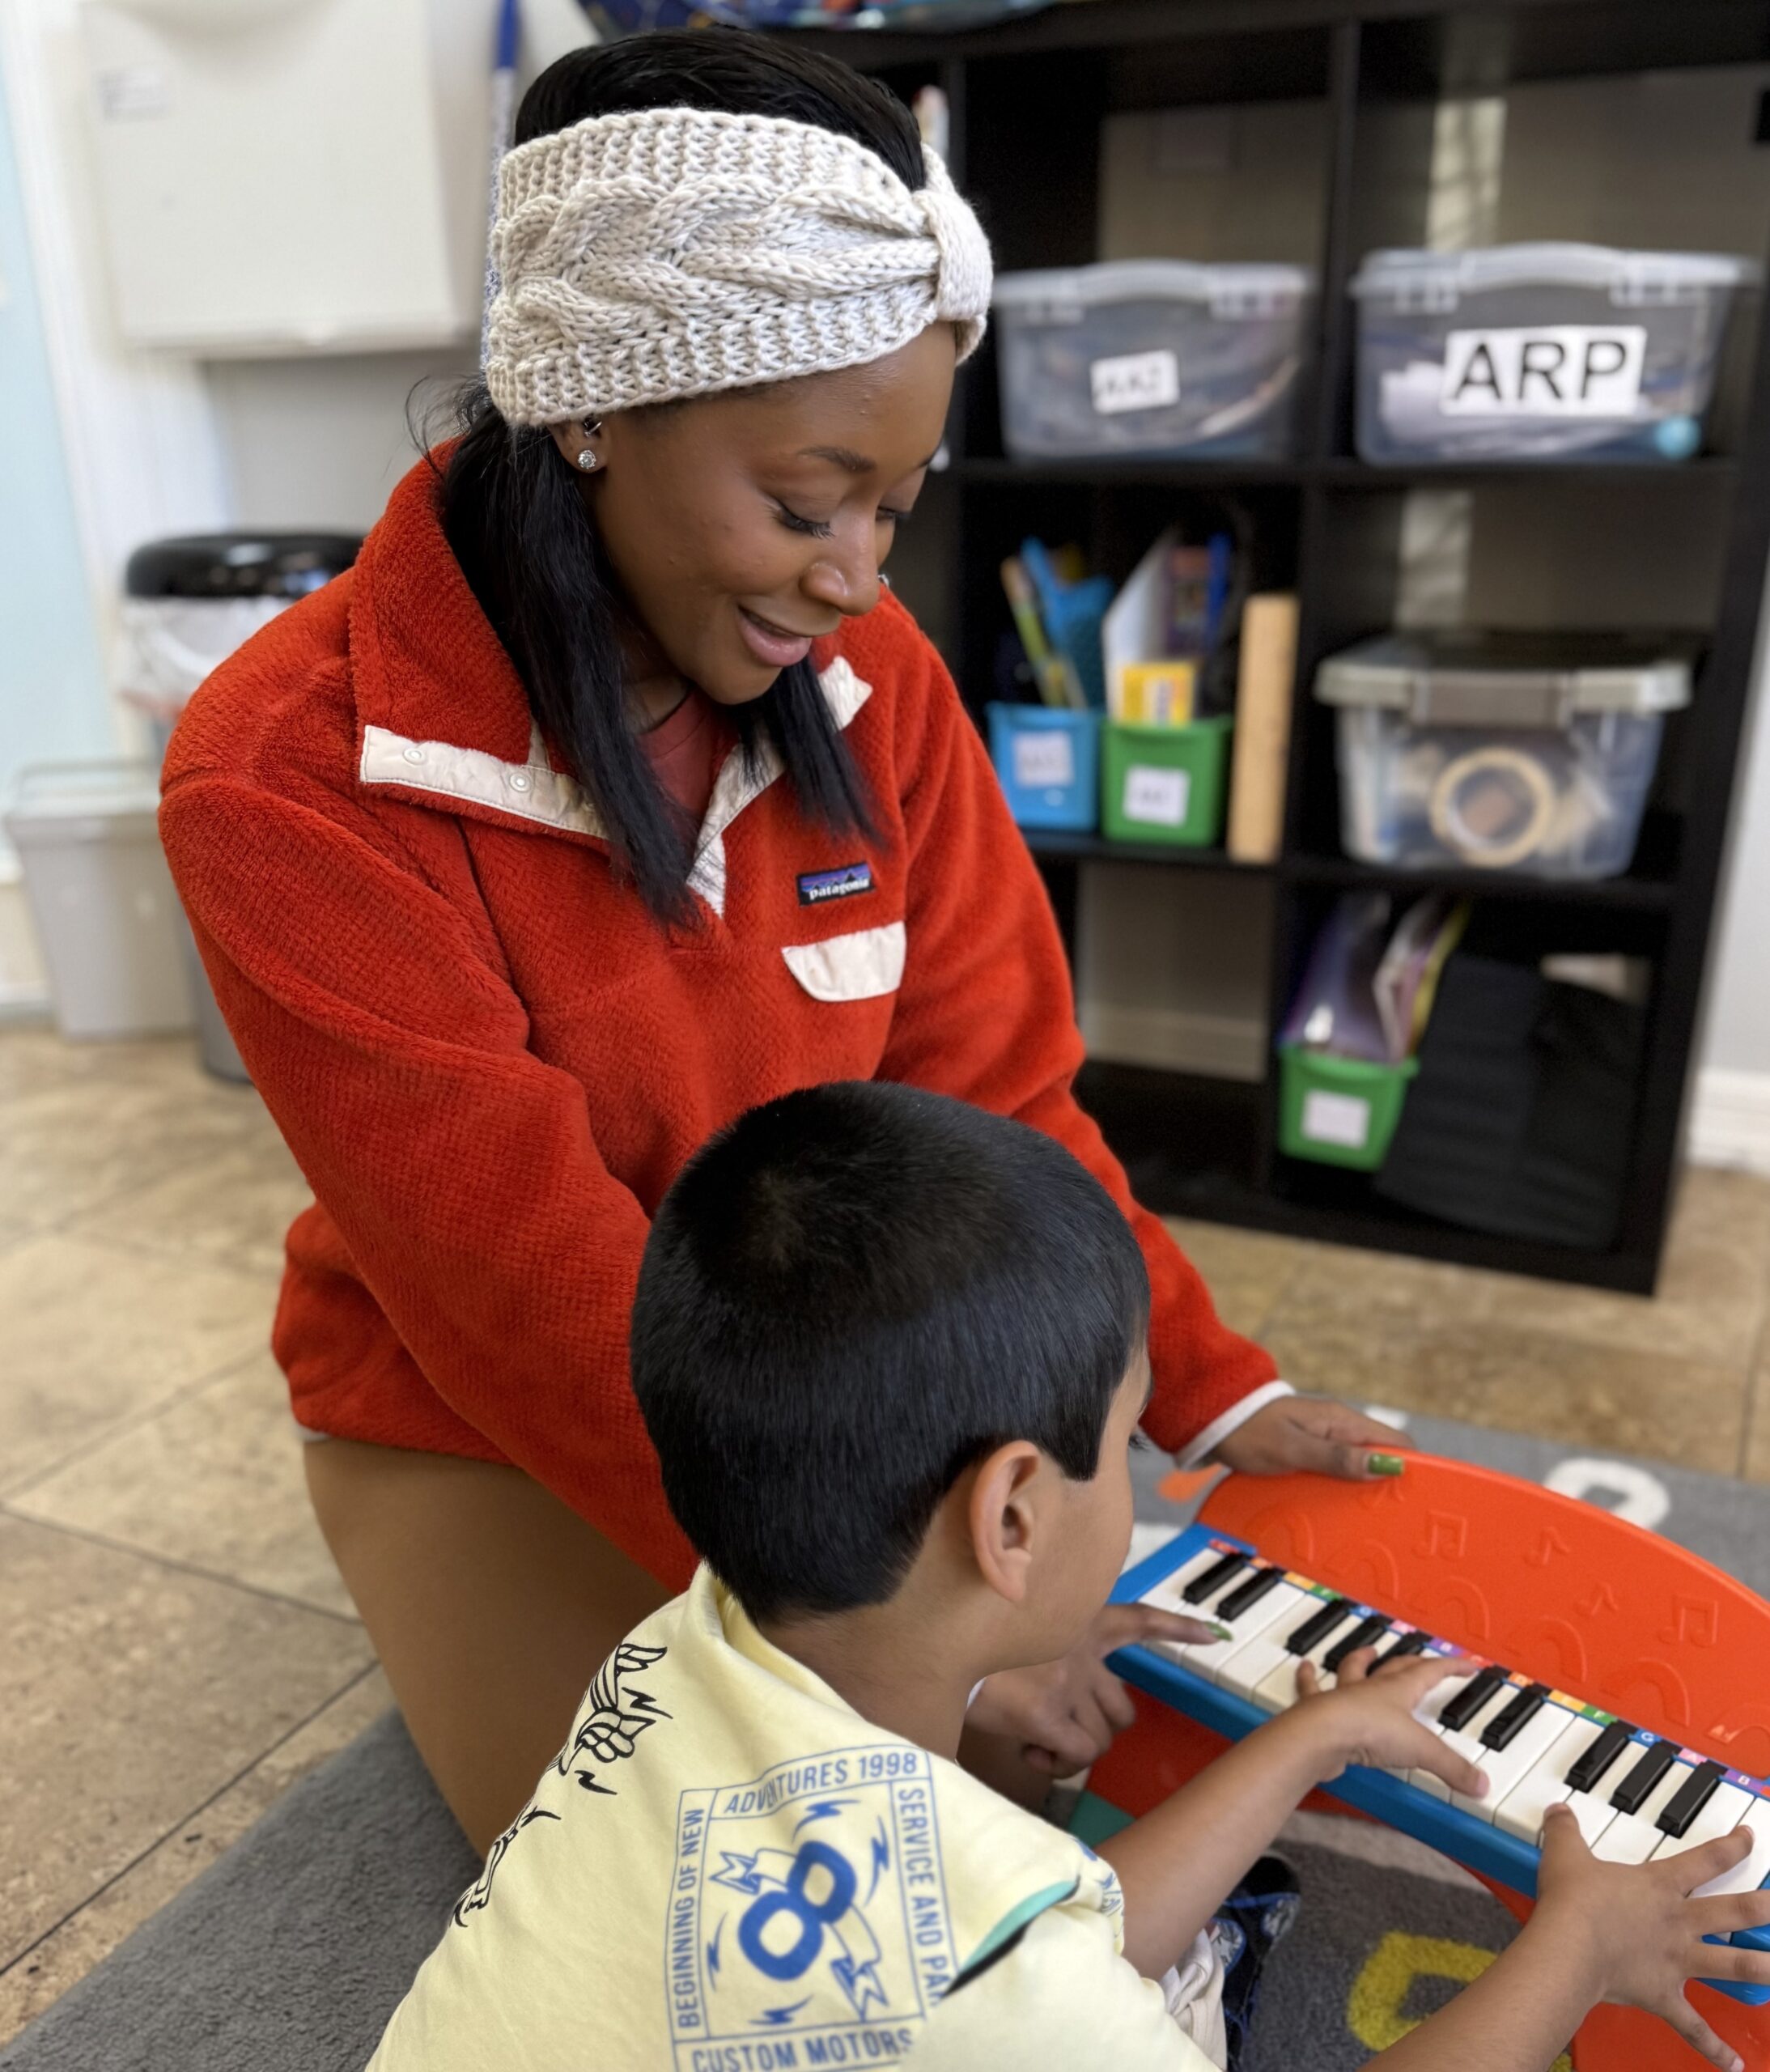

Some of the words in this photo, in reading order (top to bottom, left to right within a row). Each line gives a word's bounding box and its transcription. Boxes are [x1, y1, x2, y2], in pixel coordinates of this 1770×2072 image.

[1454, 341, 1627, 400] ARP
[809, 877, 870, 900] patagonia
[859, 1752, 917, 1780] 1998
[681, 1808, 705, 1858] NEW
[898, 1787, 936, 1887] SERVICE
[677, 1864, 698, 1891] OF
[911, 1896, 944, 1947] AND
[672, 1896, 701, 2028] BEGINNING
[691, 2040, 798, 2072] CUSTOM
[804, 2027, 914, 2065] MOTORS
